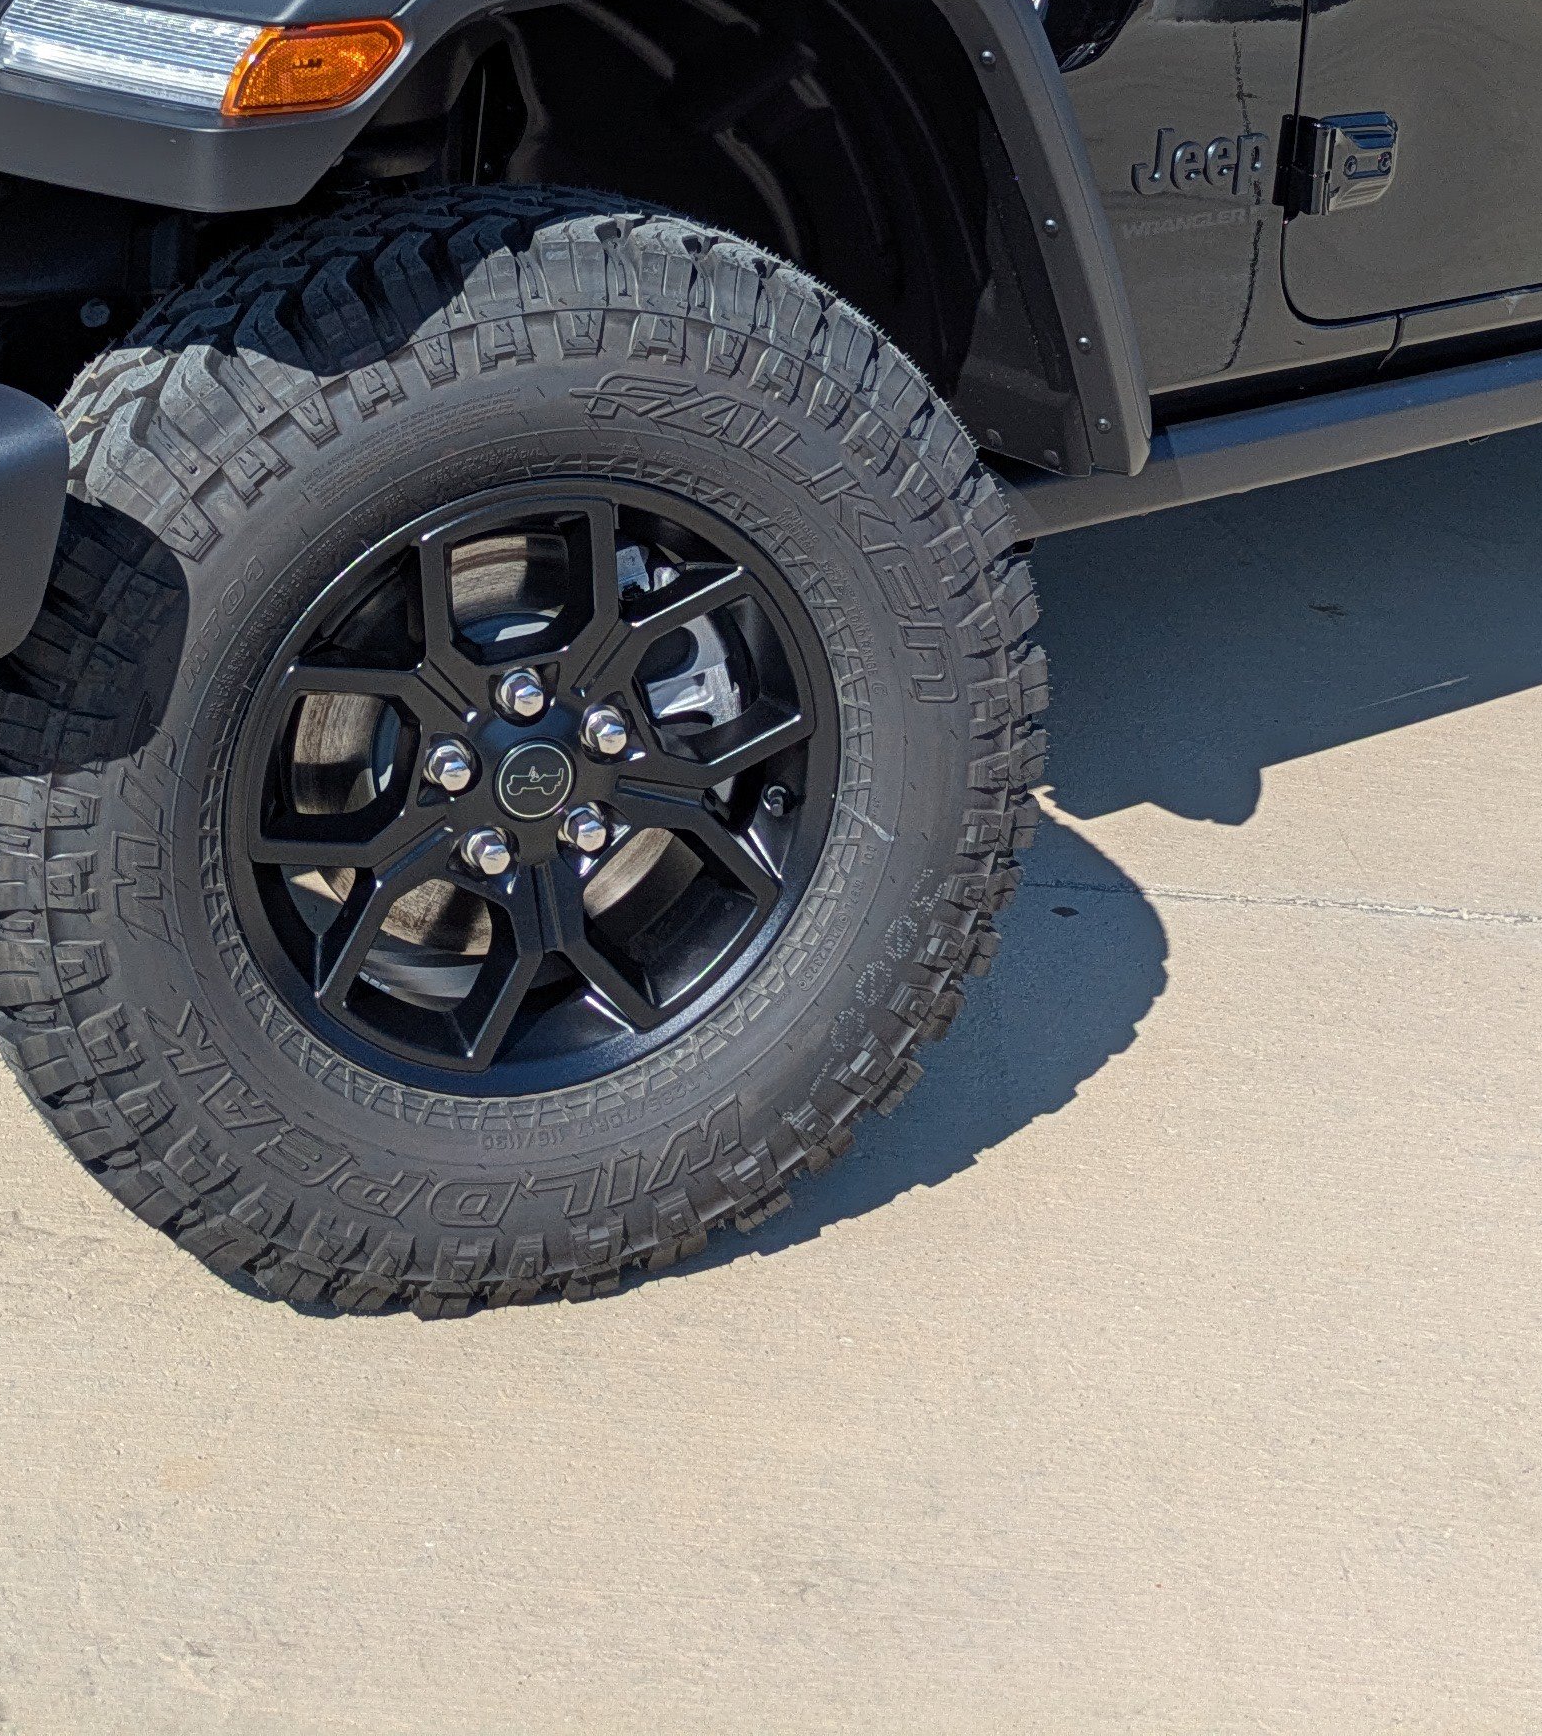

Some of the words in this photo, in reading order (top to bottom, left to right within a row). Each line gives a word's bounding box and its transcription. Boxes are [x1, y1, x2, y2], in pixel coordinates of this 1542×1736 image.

[1130, 127, 1271, 196] Jeep
[569, 371, 960, 705] FALKEN
[142, 998, 743, 1229] WILDPEAK
